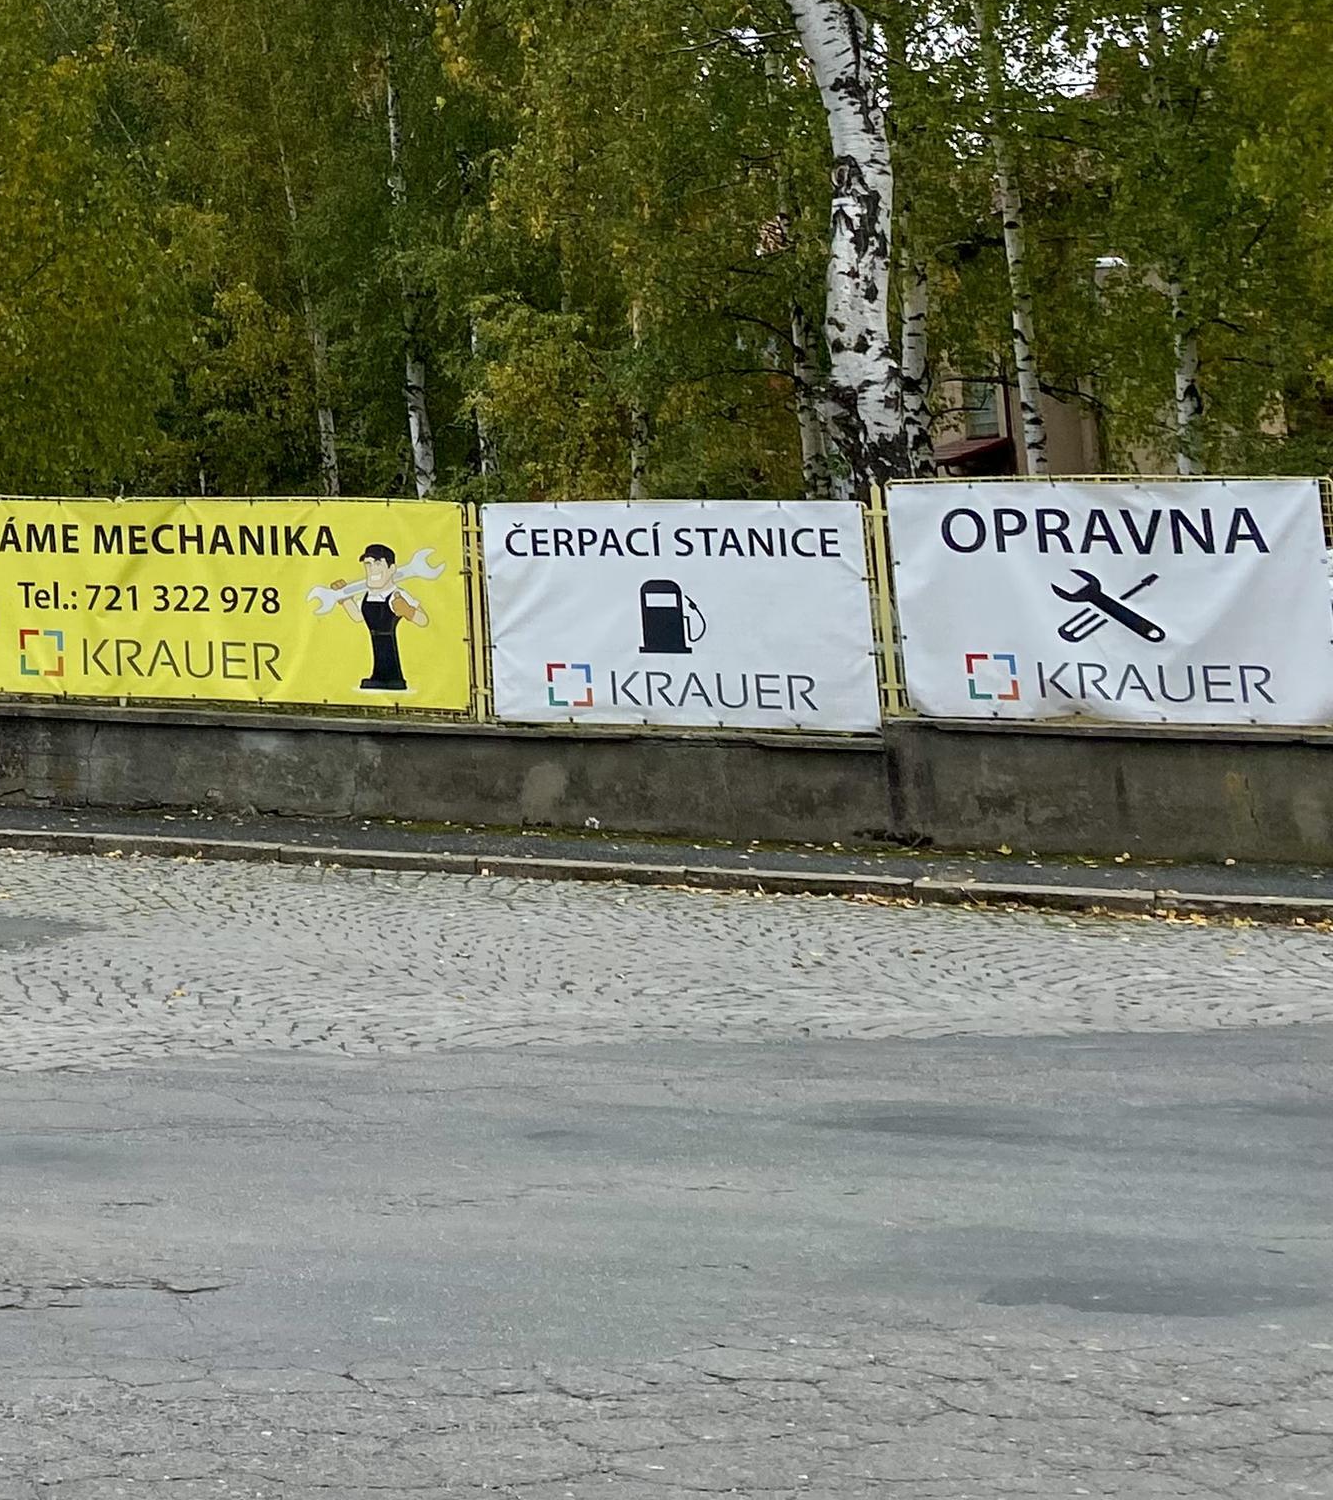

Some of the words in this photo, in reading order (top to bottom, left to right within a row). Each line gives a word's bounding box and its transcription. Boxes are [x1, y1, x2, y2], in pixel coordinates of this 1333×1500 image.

[93, 524, 339, 557] MECHANIKA
[505, 520, 663, 558] ČERPACÍ
[675, 527, 841, 558] STANICE
[939, 507, 1271, 555] OPRAVNA
[17, 581, 78, 611] Tel.:
[85, 585, 138, 611] 721
[153, 585, 210, 612] 322
[222, 585, 281, 614] 978
[82, 638, 283, 681] KRAUER
[611, 670, 818, 711] KRAUER
[1038, 662, 1277, 704] KRAUER
